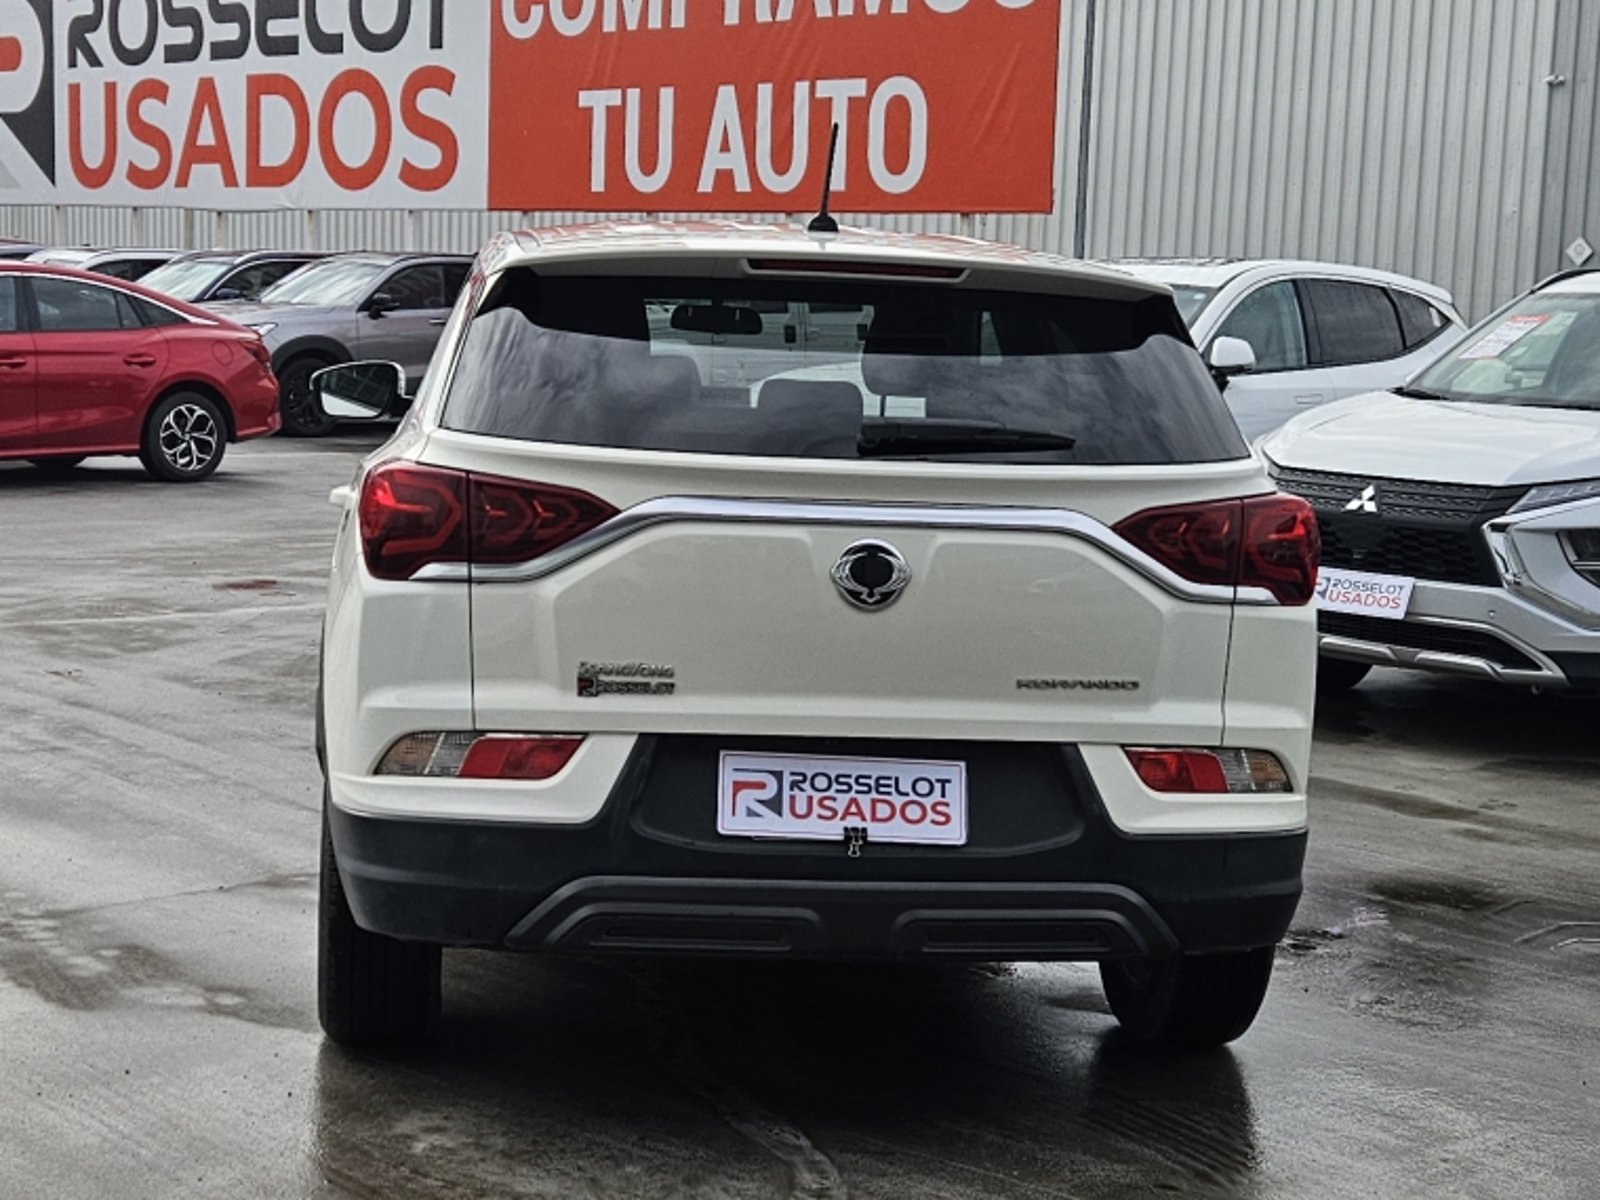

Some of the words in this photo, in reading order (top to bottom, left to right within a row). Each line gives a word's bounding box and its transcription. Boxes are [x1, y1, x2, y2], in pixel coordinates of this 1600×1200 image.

[67, 65, 459, 191] USADOS
[578, 86, 675, 193] TU
[696, 75, 928, 194] AUTO
[1328, 590, 1401, 610] USADOS
[1331, 578, 1405, 596] ROSSELOT
[789, 771, 952, 799] ROSSELOT
[788, 794, 952, 827] USADOS
